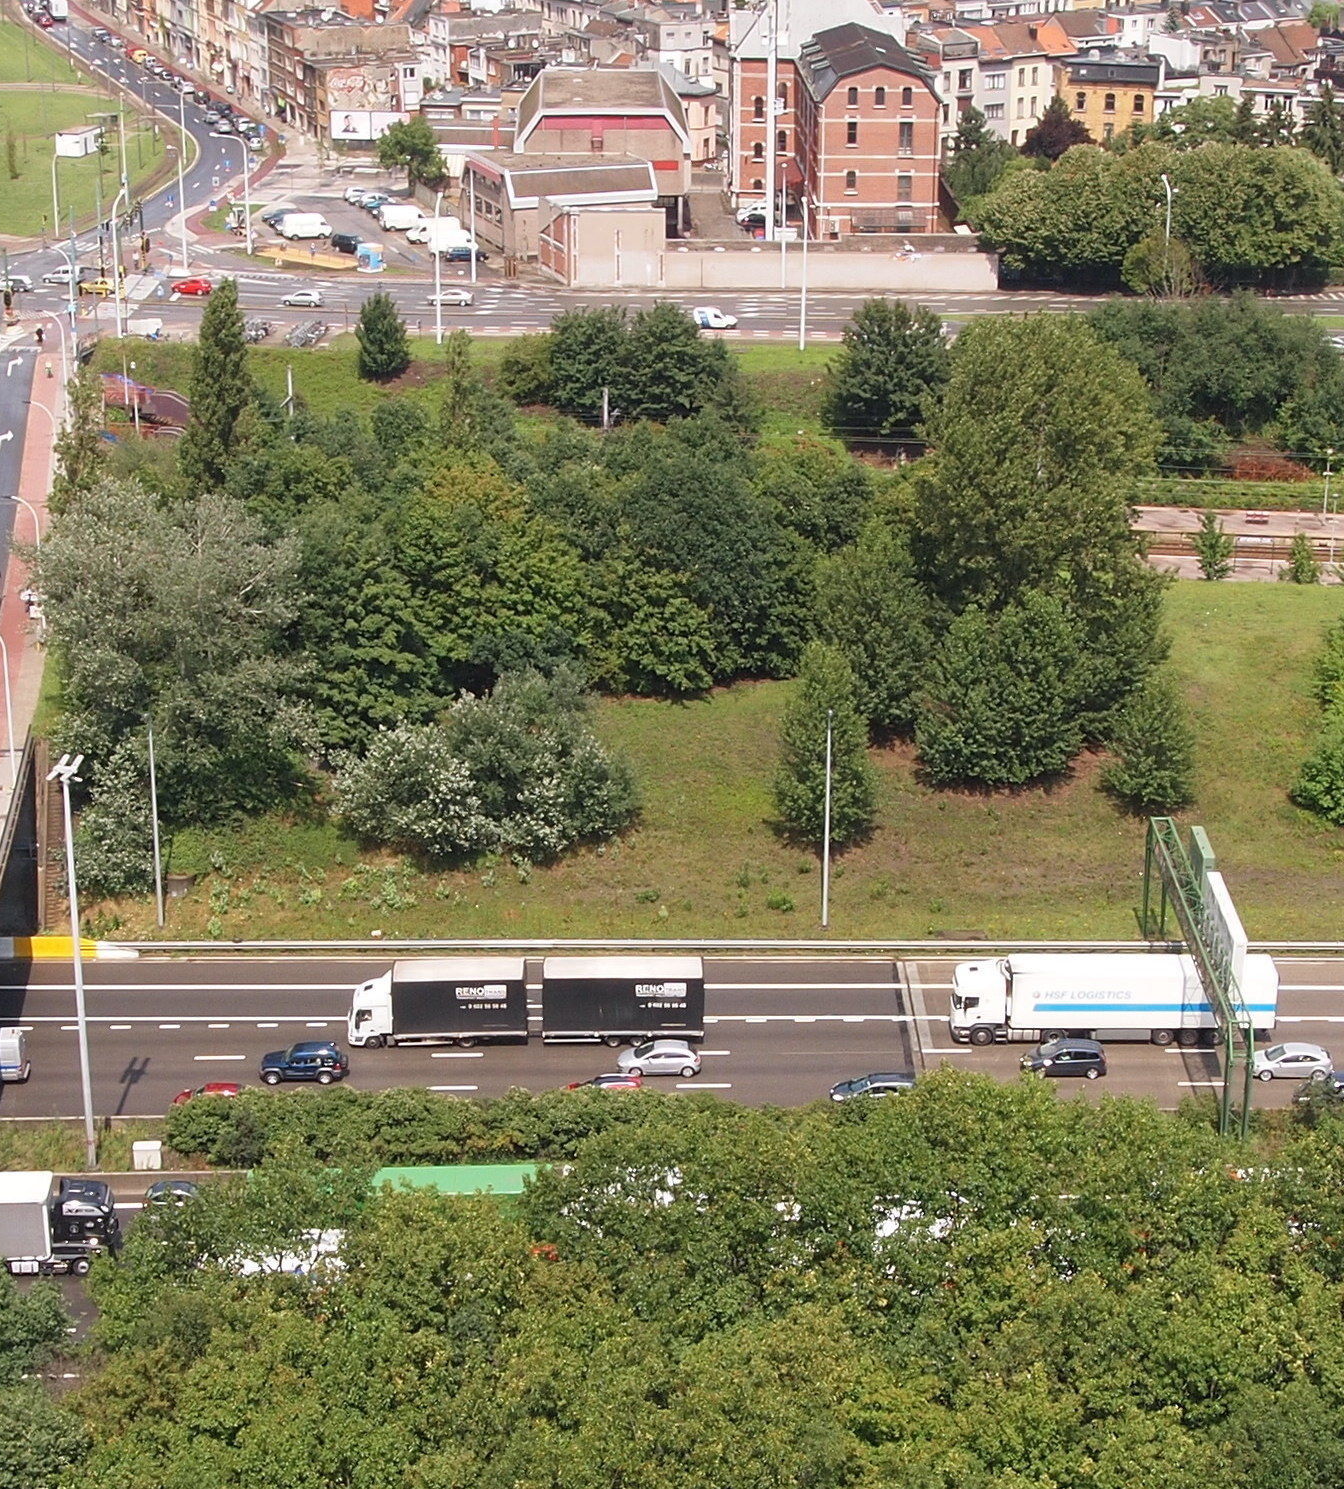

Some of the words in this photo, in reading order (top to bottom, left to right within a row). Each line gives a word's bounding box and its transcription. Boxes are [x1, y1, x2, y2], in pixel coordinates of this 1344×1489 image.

[455, 986, 485, 996] RENO
[635, 984, 664, 994] RENO
[1044, 990, 1067, 1000] HSF
[1070, 990, 1133, 1000] LOGISTICS
